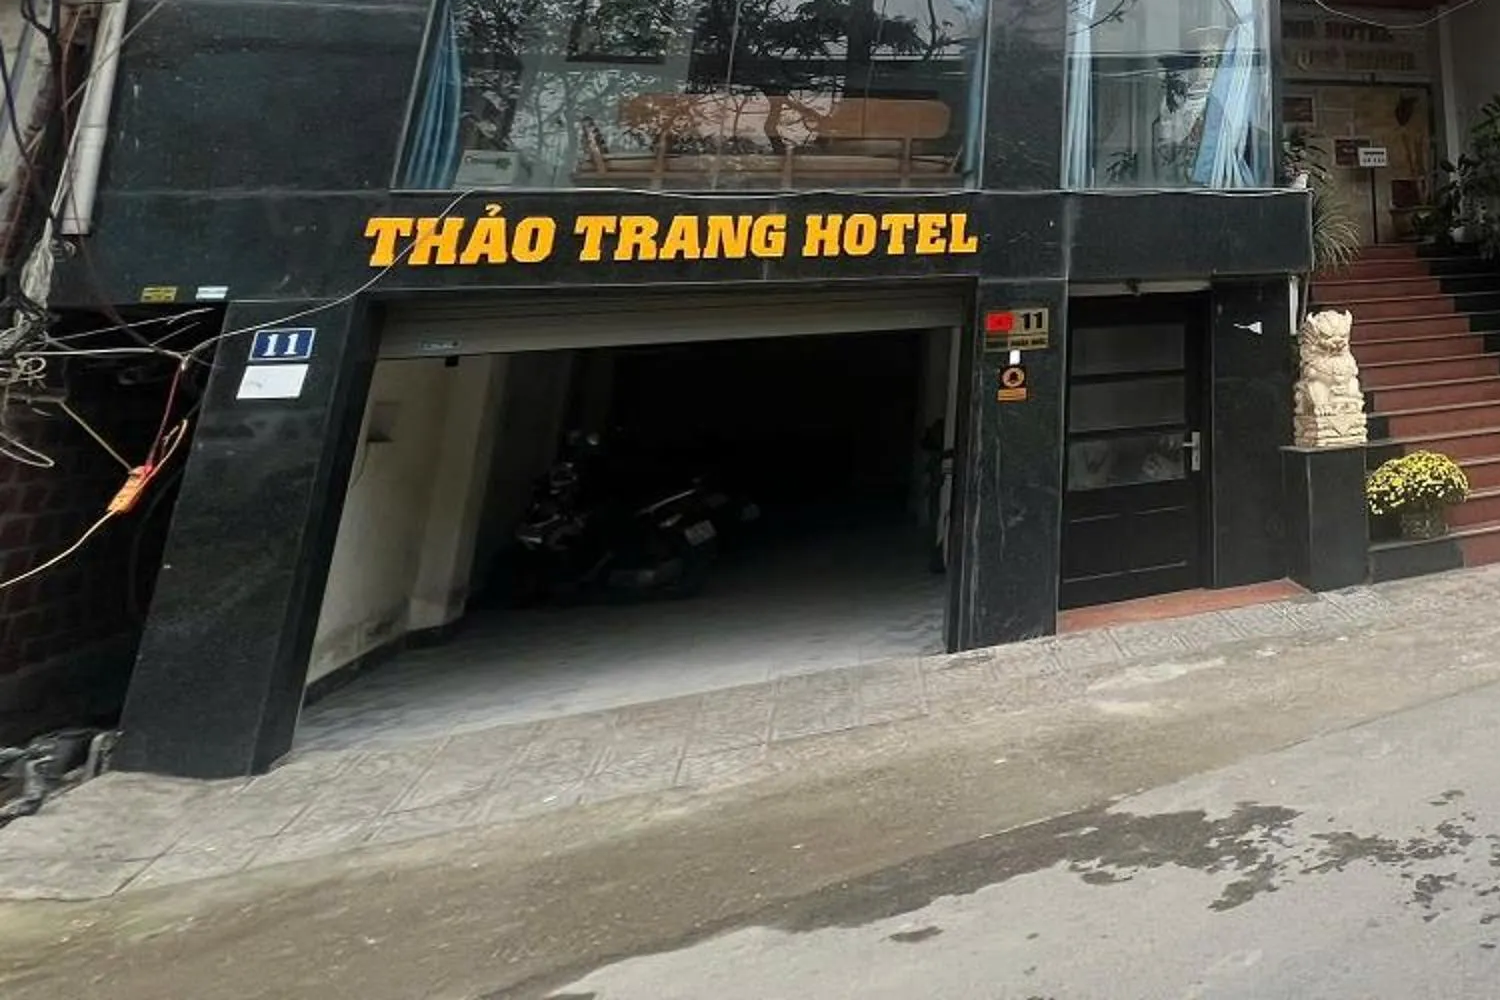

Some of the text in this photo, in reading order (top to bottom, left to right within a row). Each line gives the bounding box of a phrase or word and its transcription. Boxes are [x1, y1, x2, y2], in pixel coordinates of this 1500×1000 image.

[363, 204, 979, 267] THẢO TRANG HOTEL
[1020, 311, 1043, 330] 11
[262, 333, 300, 357] 11
